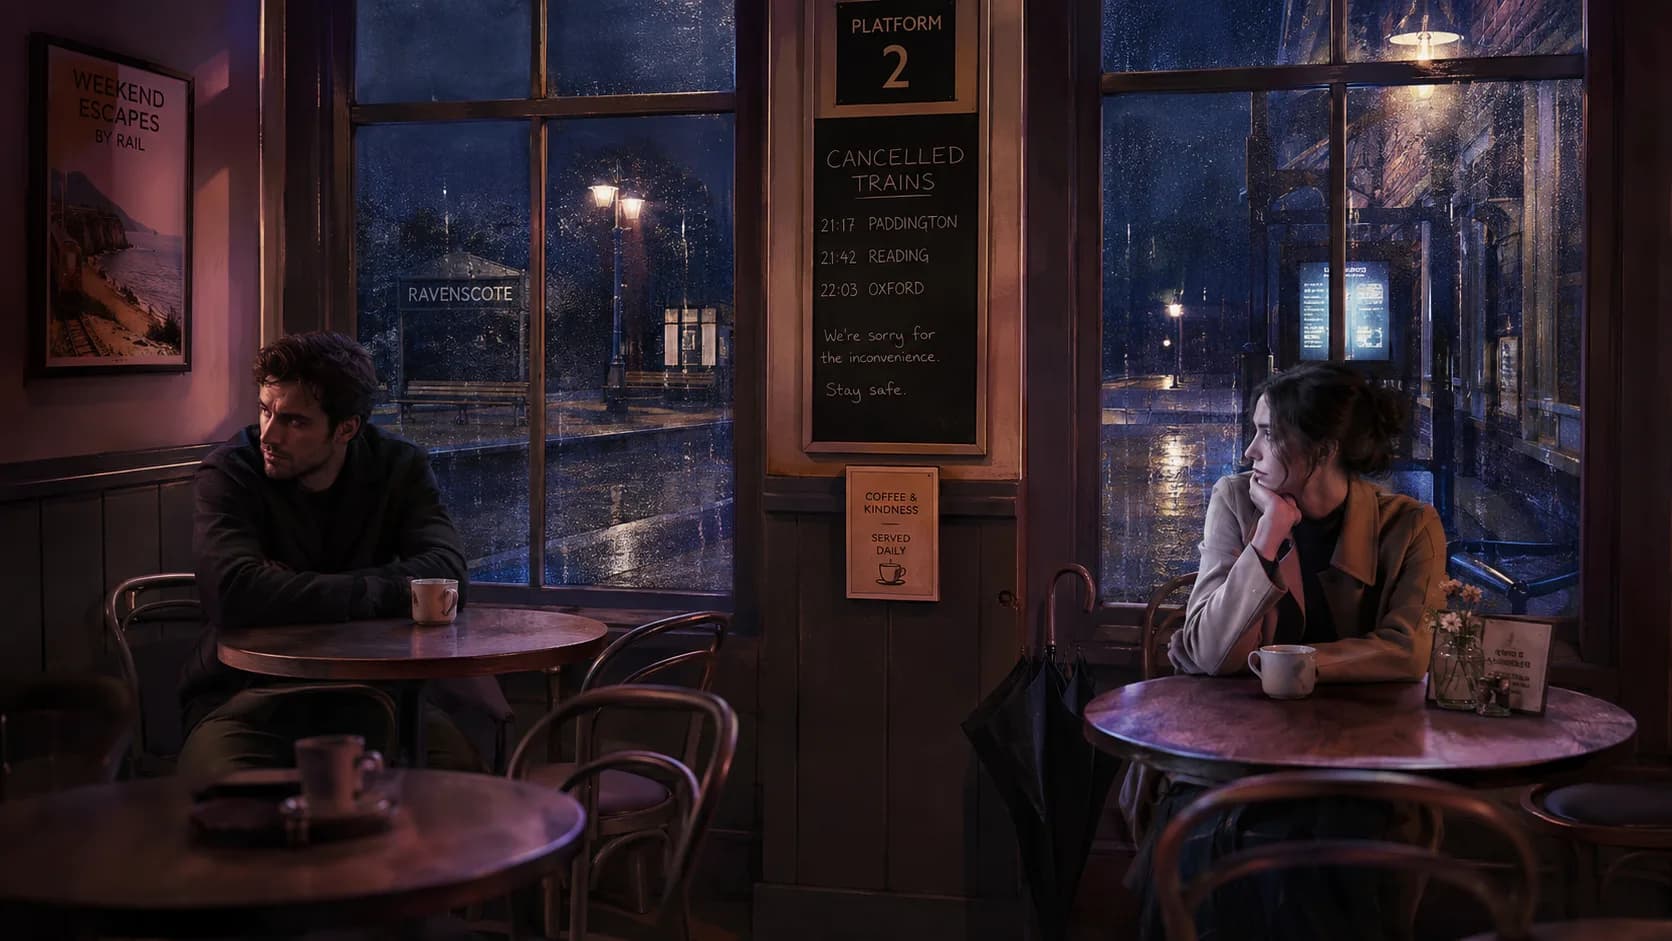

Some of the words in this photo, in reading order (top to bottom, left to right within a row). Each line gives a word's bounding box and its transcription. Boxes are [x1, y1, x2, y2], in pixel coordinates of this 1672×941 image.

[851, 15, 942, 34] PLATFORM
[882, 44, 910, 89] 2
[72, 67, 165, 108] WEEKEND
[80, 98, 160, 132] ESCAPES
[95, 128, 113, 145] BY
[117, 133, 145, 152] RAIL
[826, 146, 965, 169] CANCELLED
[851, 172, 935, 193] TRAINS
[820, 218, 856, 233] 21:17
[868, 215, 958, 233] PADDINGTON
[820, 250, 857, 265] 21:42
[868, 248, 929, 264] READING
[408, 286, 513, 302] RAVENSCOTE
[820, 282, 858, 297] 22:03
[868, 281, 925, 296] OXFORD
[824, 328, 862, 343] We're
[868, 332, 904, 349] sorry
[911, 325, 936, 341] for
[820, 352, 842, 364] the
[849, 351, 940, 363] inconvenience.
[825, 382, 862, 404] Stay
[869, 380, 907, 396] safe.
[865, 491, 906, 502] COFFEE
[910, 493, 918, 502] &
[864, 504, 919, 515] KINDNESS
[872, 533, 911, 542] SERVED
[876, 546, 906, 555] DAILY
